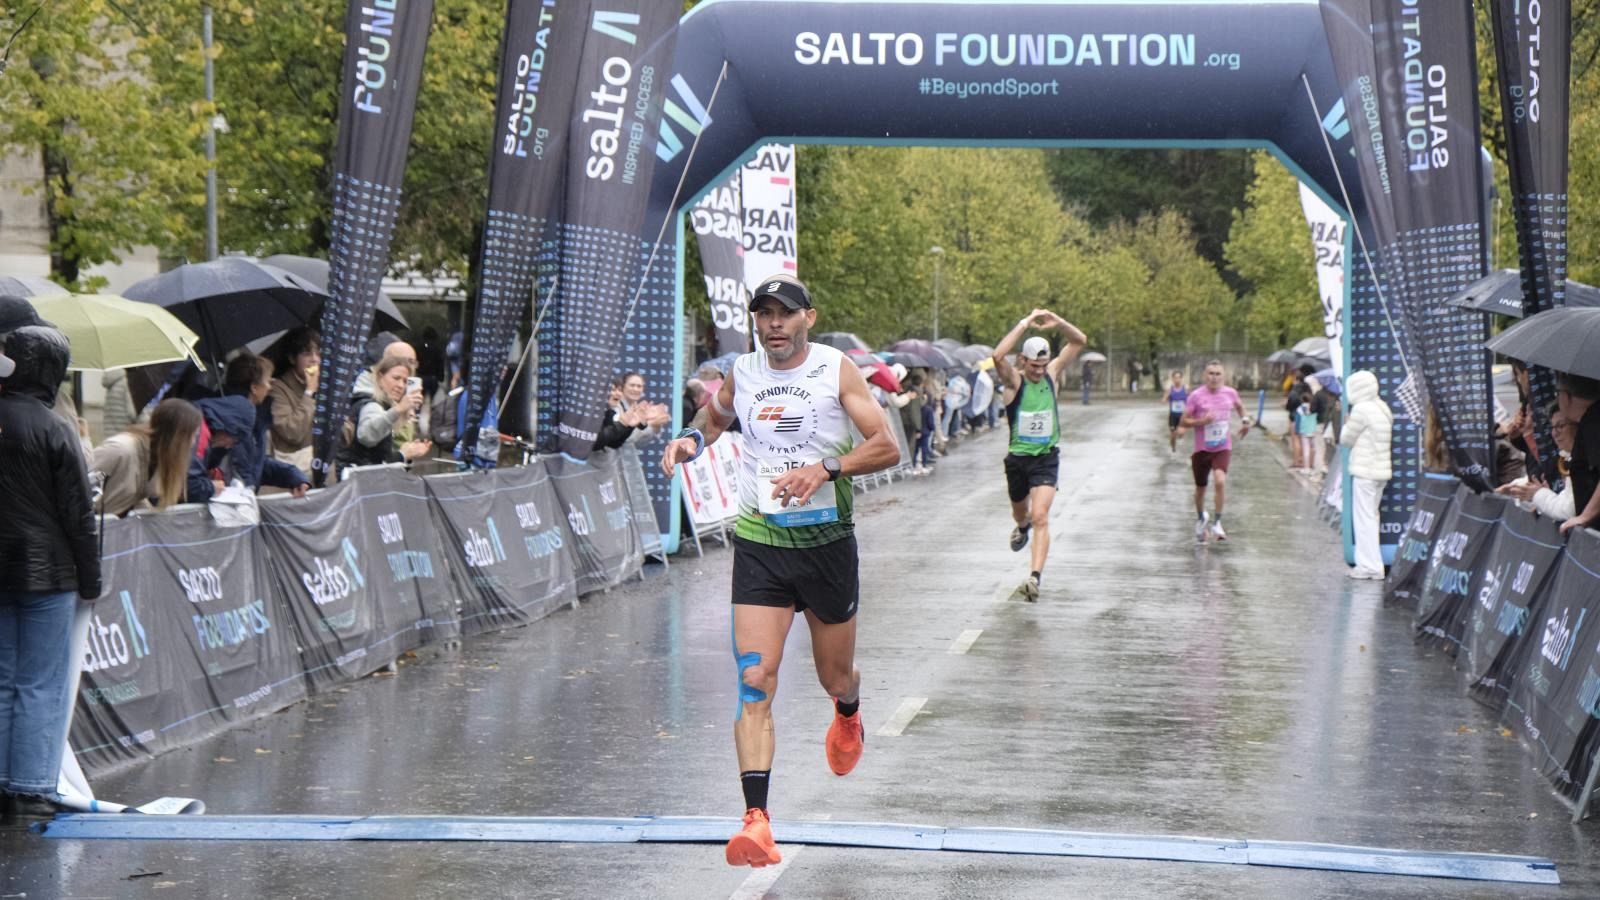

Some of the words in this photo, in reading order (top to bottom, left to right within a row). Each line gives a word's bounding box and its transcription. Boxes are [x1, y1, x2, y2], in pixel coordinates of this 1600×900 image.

[794, 32, 924, 66] SALTO
[935, 33, 1196, 67] FOUNDATION
[1203, 50, 1241, 71] .org
[503, 54, 530, 156] SALTO
[918, 77, 1059, 99] #BeyondSport
[582, 56, 632, 182] salto
[621, 122, 644, 184] INSPIRED
[634, 64, 654, 120] ACCESS
[532, 127, 549, 161] .org
[1498, 297, 1523, 309] INE
[1031, 421, 1043, 430] 22
[768, 443, 804, 454] HYROX
[760, 466, 783, 474] SALTO
[178, 566, 223, 603] SALTO
[302, 556, 350, 605] salto
